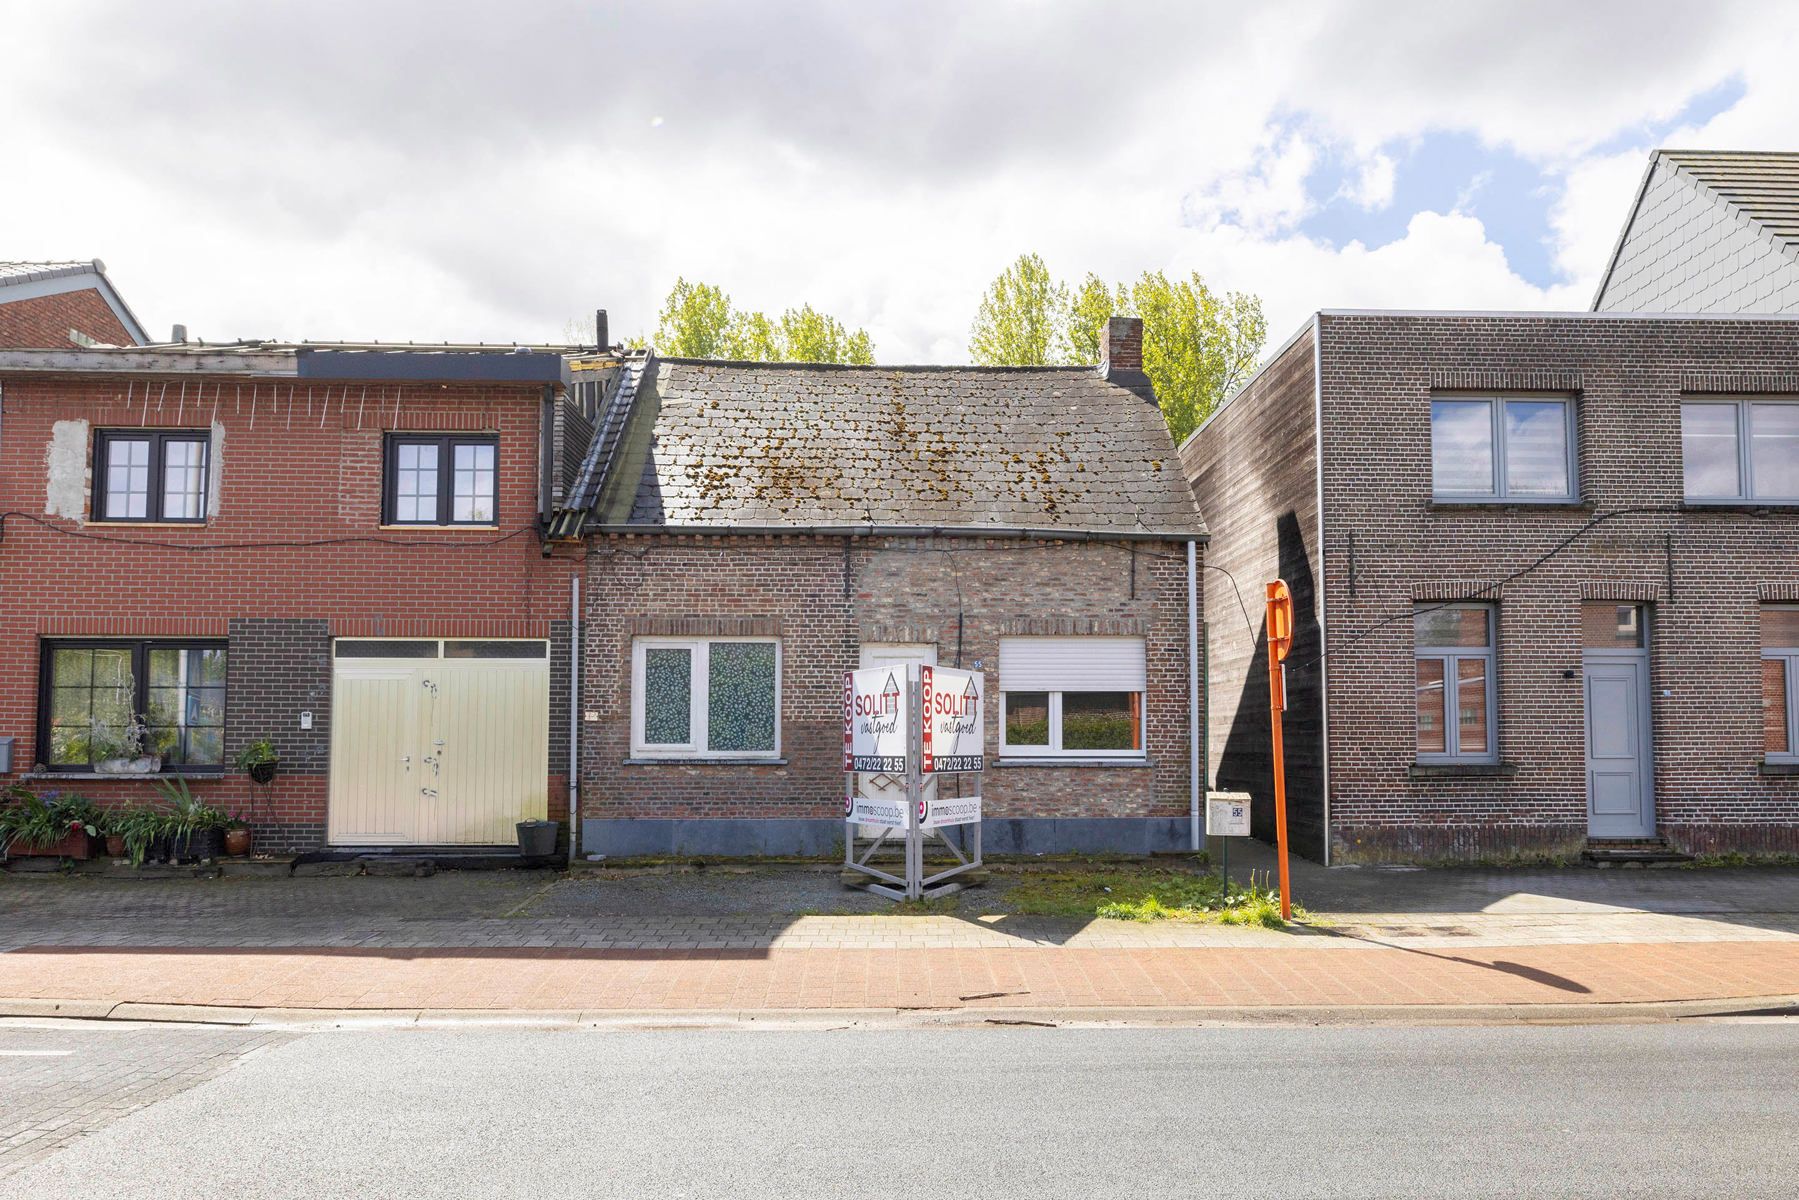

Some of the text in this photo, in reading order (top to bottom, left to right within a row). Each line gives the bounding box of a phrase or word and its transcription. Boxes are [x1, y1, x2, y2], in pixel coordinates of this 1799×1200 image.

[974, 660, 982, 668] 55
[855, 692, 900, 717] SOLITT
[934, 692, 979, 716] SOLITT
[860, 707, 898, 755] vastgoed
[923, 670, 932, 769] TE KOOP
[940, 711, 977, 755] vastgoed
[845, 742, 852, 768] TE
[854, 756, 904, 771] 0472/22 22 55
[934, 757, 982, 771] 0472/22 22 55
[856, 801, 904, 819] immoscoop.be
[931, 801, 978, 817] immoscoop.be
